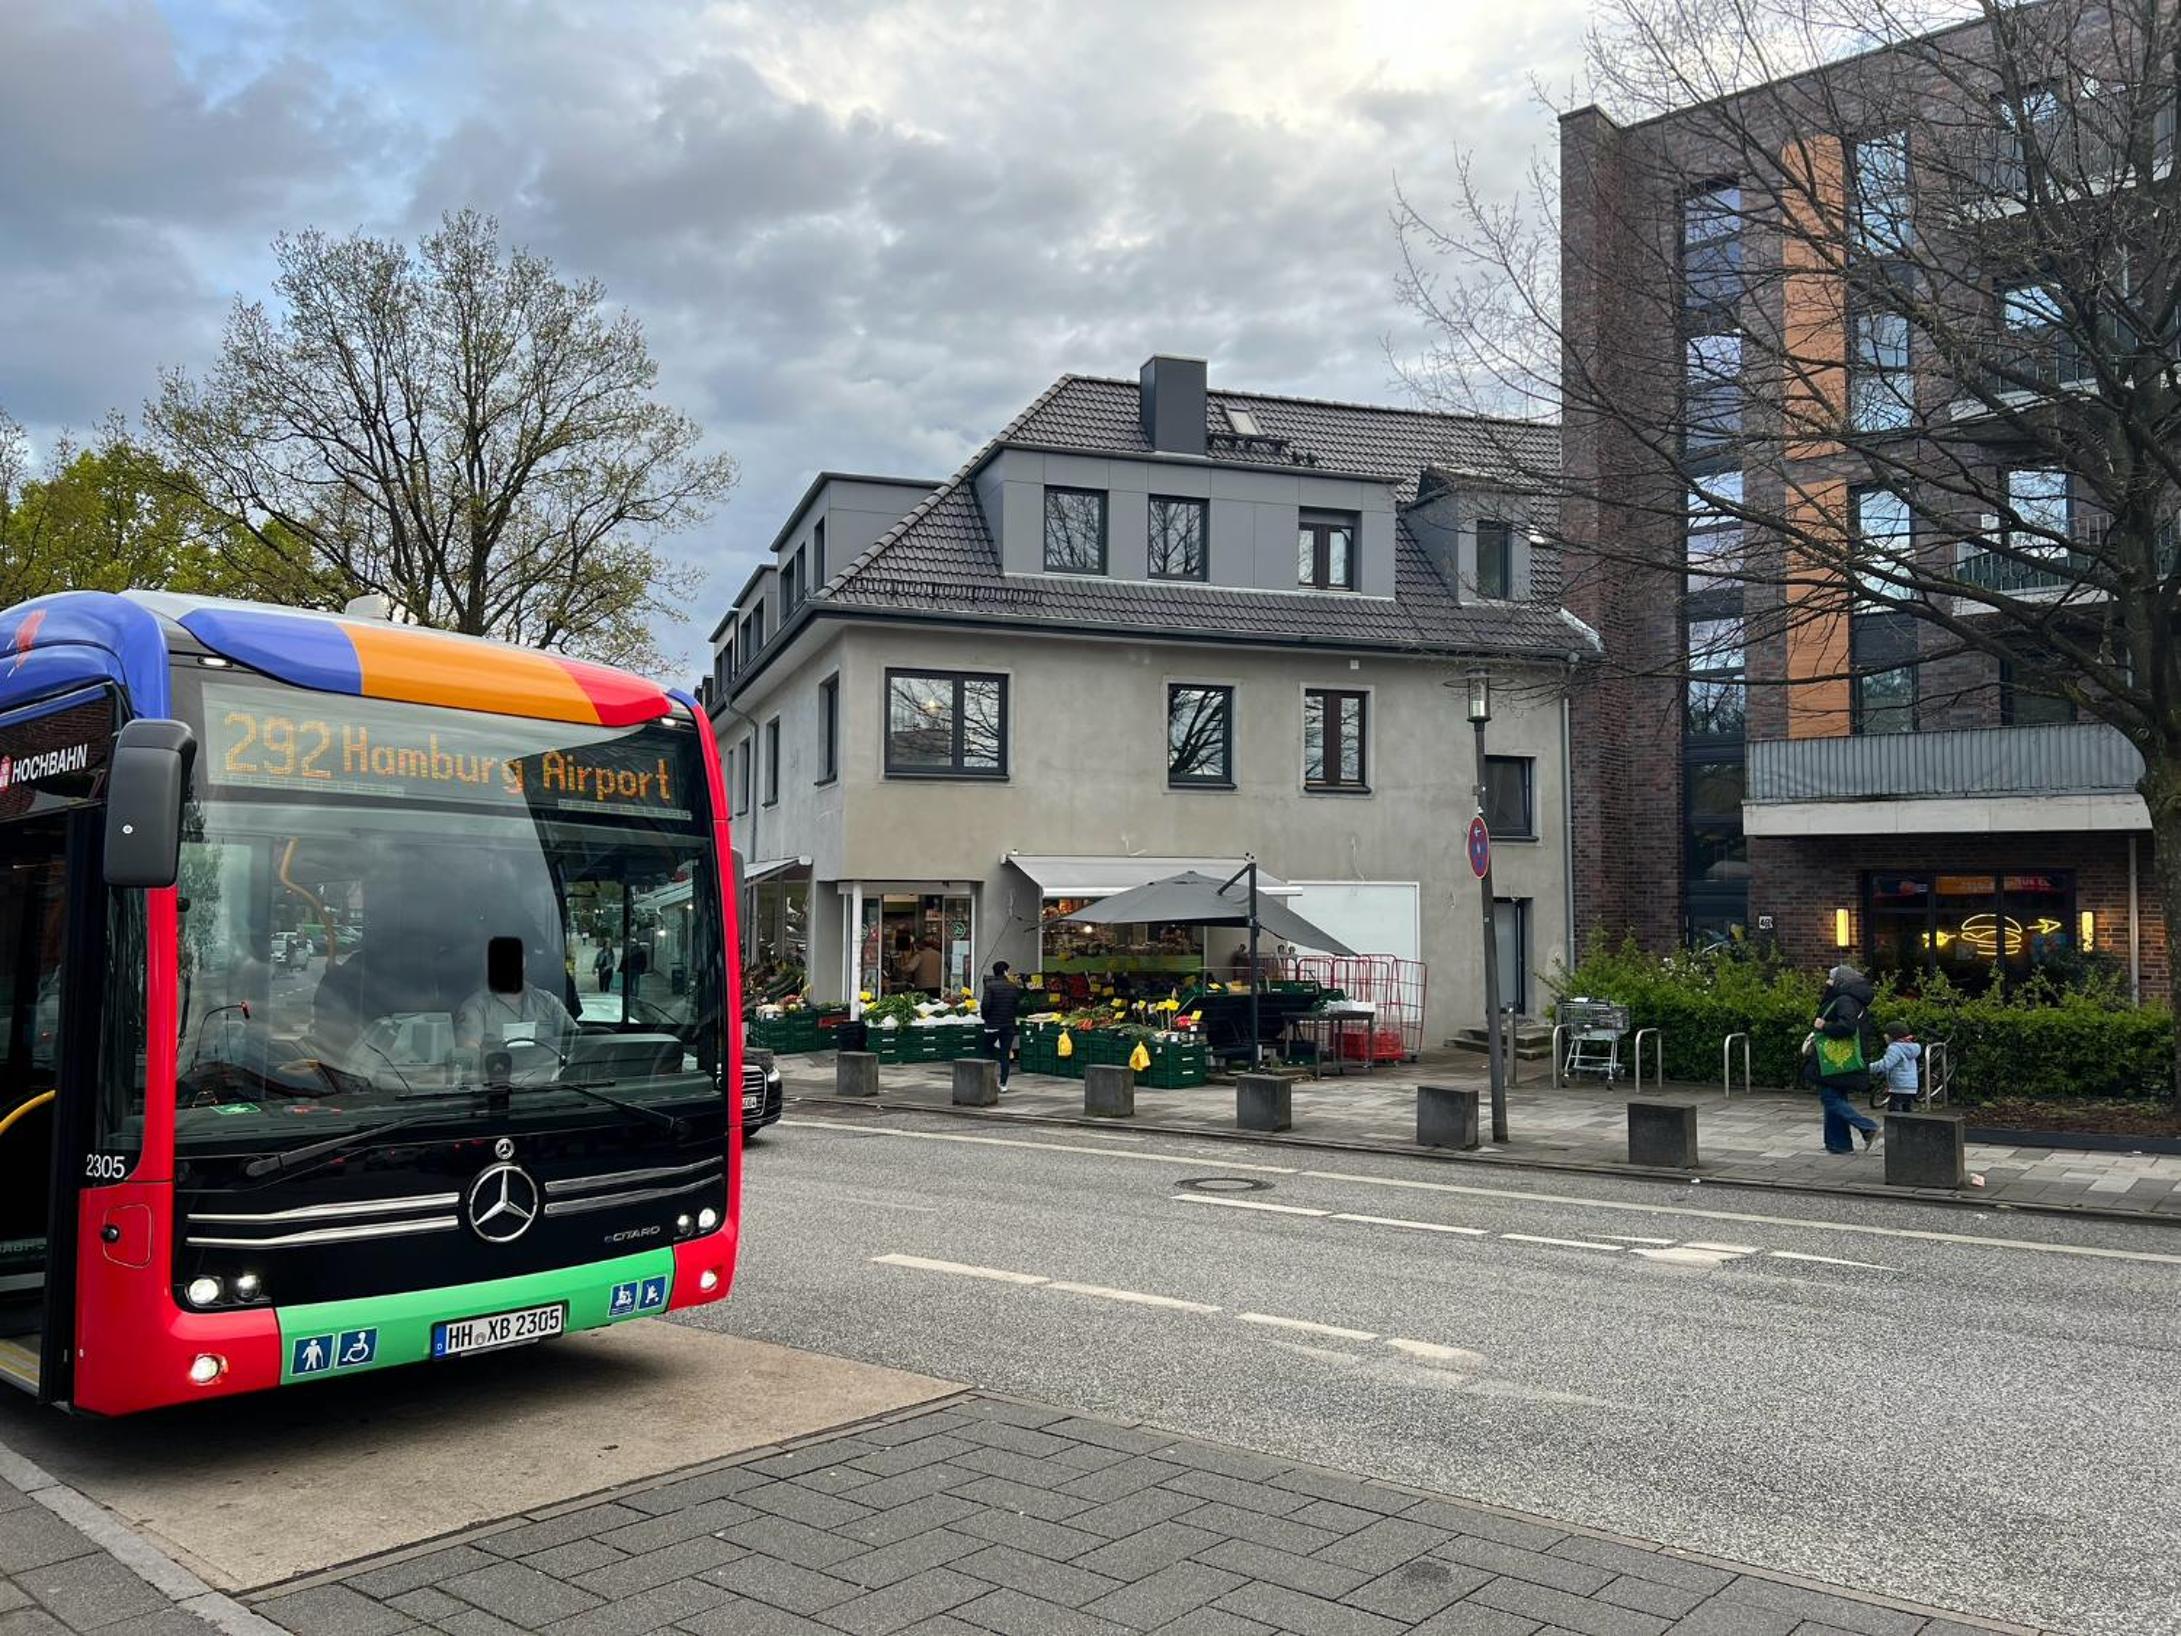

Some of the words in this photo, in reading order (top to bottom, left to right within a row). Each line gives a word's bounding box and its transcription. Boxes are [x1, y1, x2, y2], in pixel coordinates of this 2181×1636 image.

[11, 743, 88, 784] HOCHBAHN
[224, 711, 331, 778] 292
[342, 724, 524, 795] Hamburg
[542, 750, 670, 801] Airport
[86, 1153, 126, 1179] 2305
[447, 1323, 473, 1351] HH
[487, 1317, 511, 1343] XB
[515, 1308, 560, 1337] 2305
